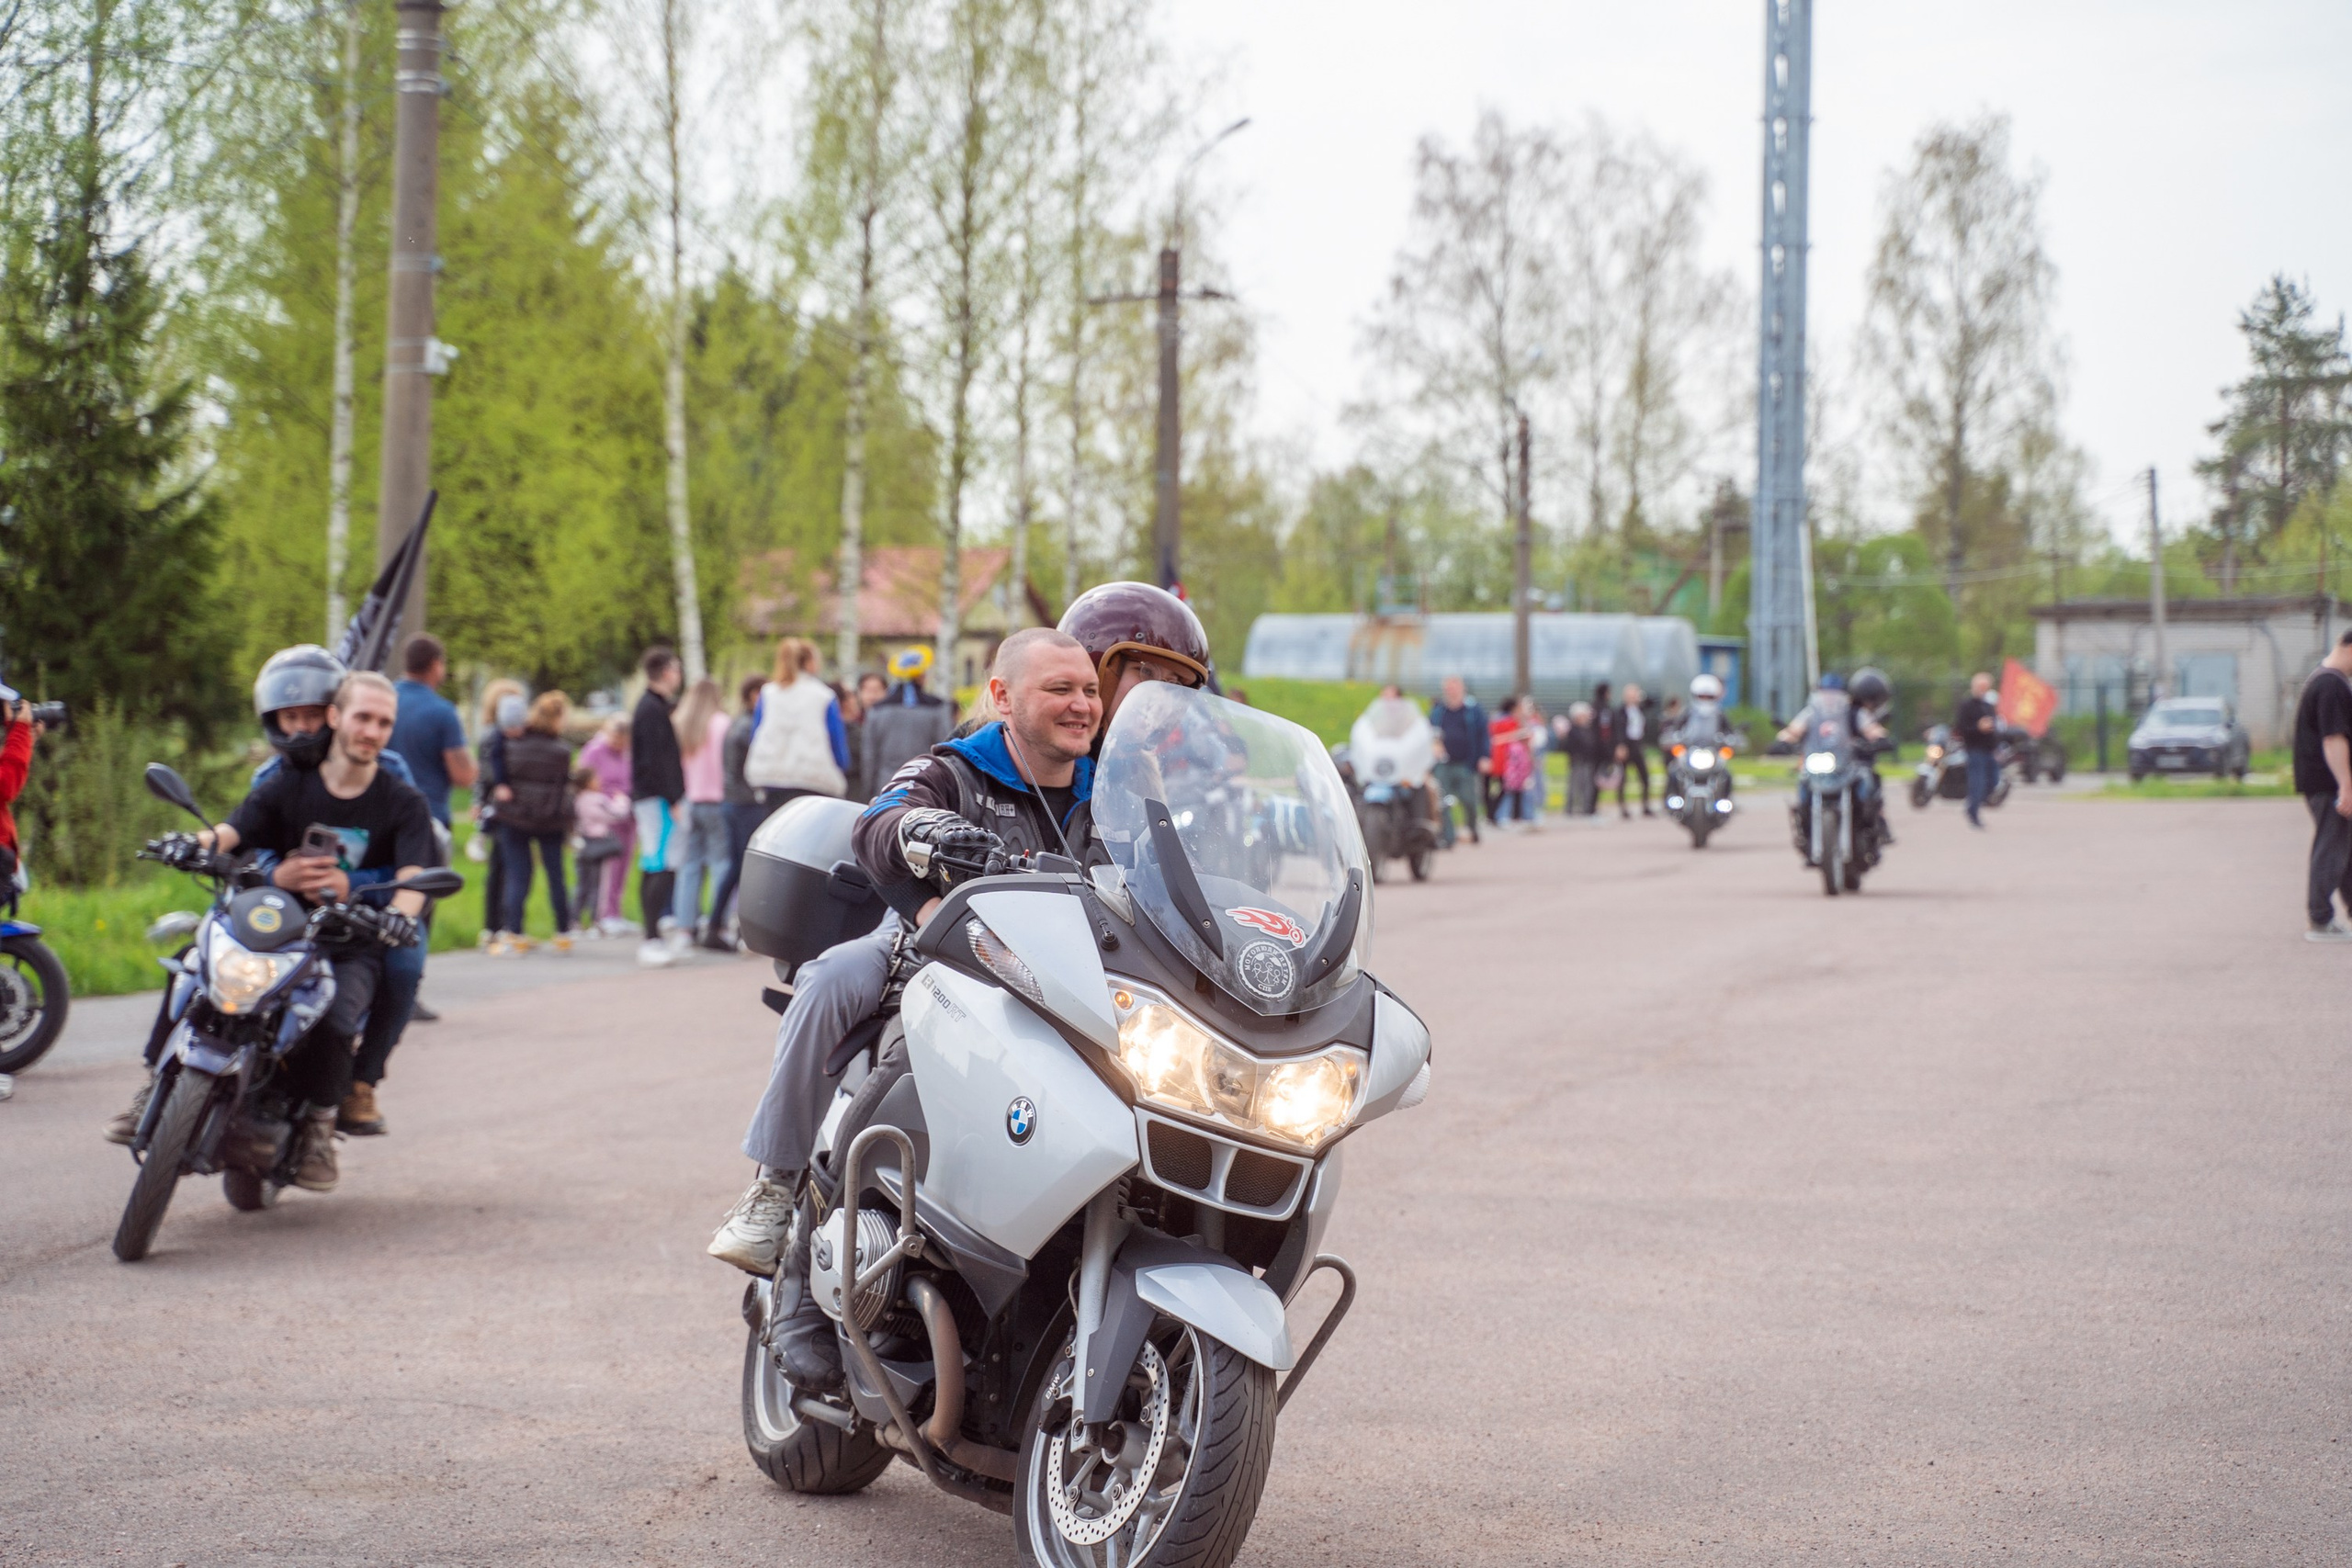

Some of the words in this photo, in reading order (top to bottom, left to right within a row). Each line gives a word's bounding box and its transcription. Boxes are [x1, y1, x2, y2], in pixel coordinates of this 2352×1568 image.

[1245, 945, 1279, 971] МОТОЛЮДИ
[1258, 983, 1272, 992] СПБ
[1012, 1101, 1034, 1118] BMW
[1045, 1373, 1060, 1400] BMW
